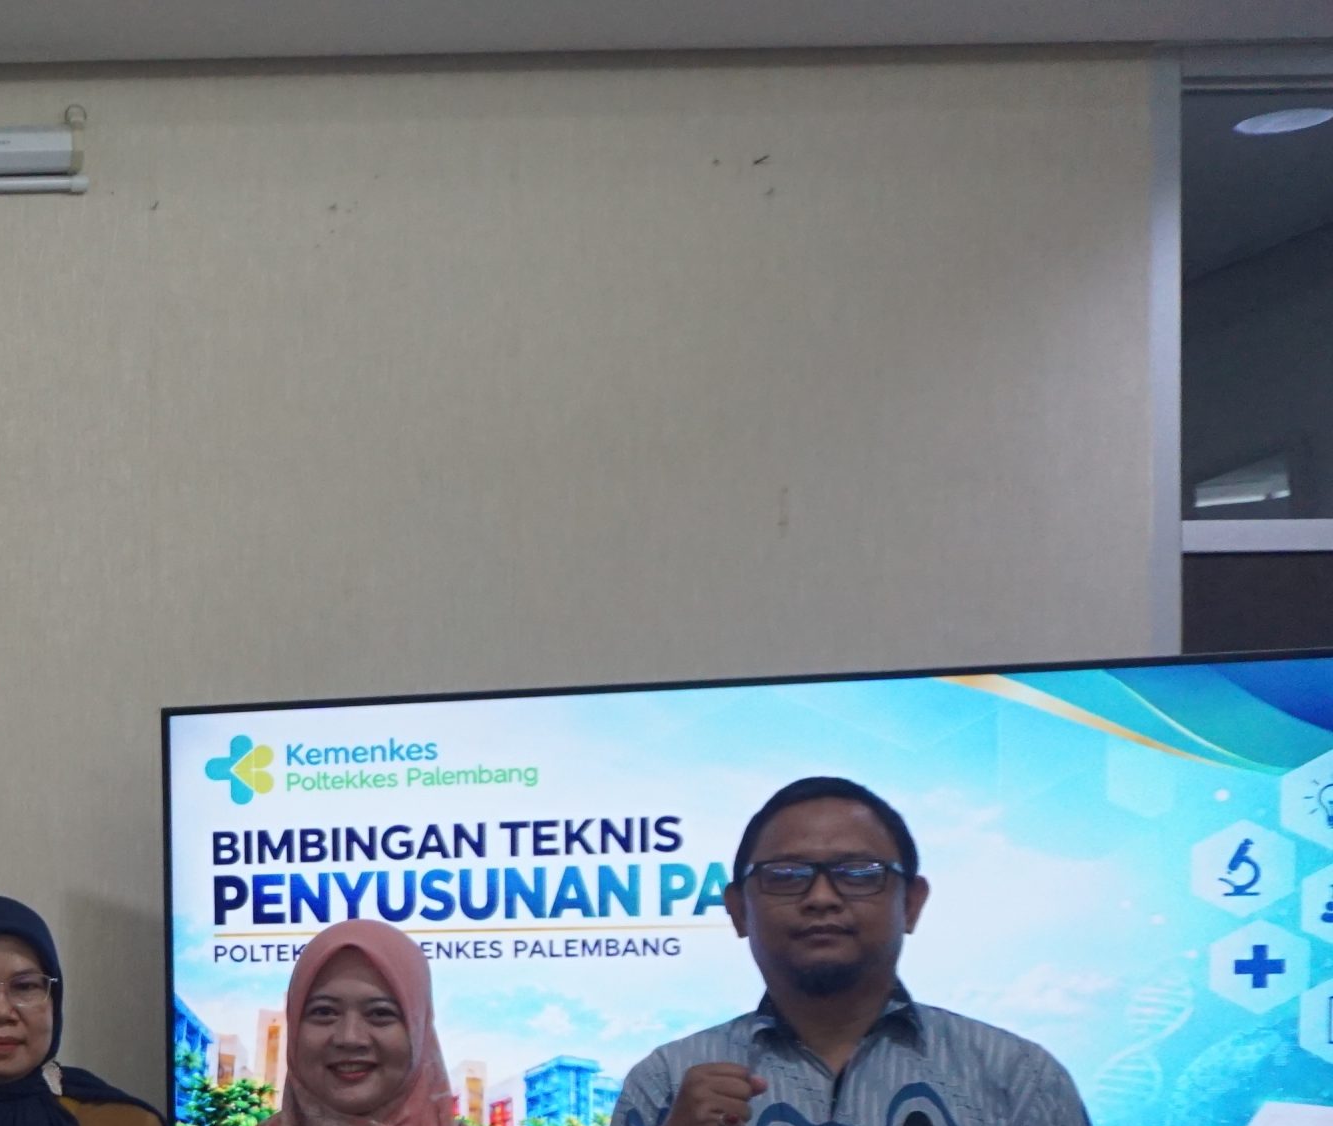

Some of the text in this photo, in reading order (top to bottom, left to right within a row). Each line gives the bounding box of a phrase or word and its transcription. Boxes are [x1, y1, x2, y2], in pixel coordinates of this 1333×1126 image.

[286, 738, 438, 766] Kemenkes
[286, 764, 538, 792] Poltekkes Palembang
[211, 815, 683, 866] BIMBINGAN TEKNIS
[212, 864, 641, 926] PENYUSUNAN
[214, 936, 682, 964] POLTEK ENKES PALEMBANG
